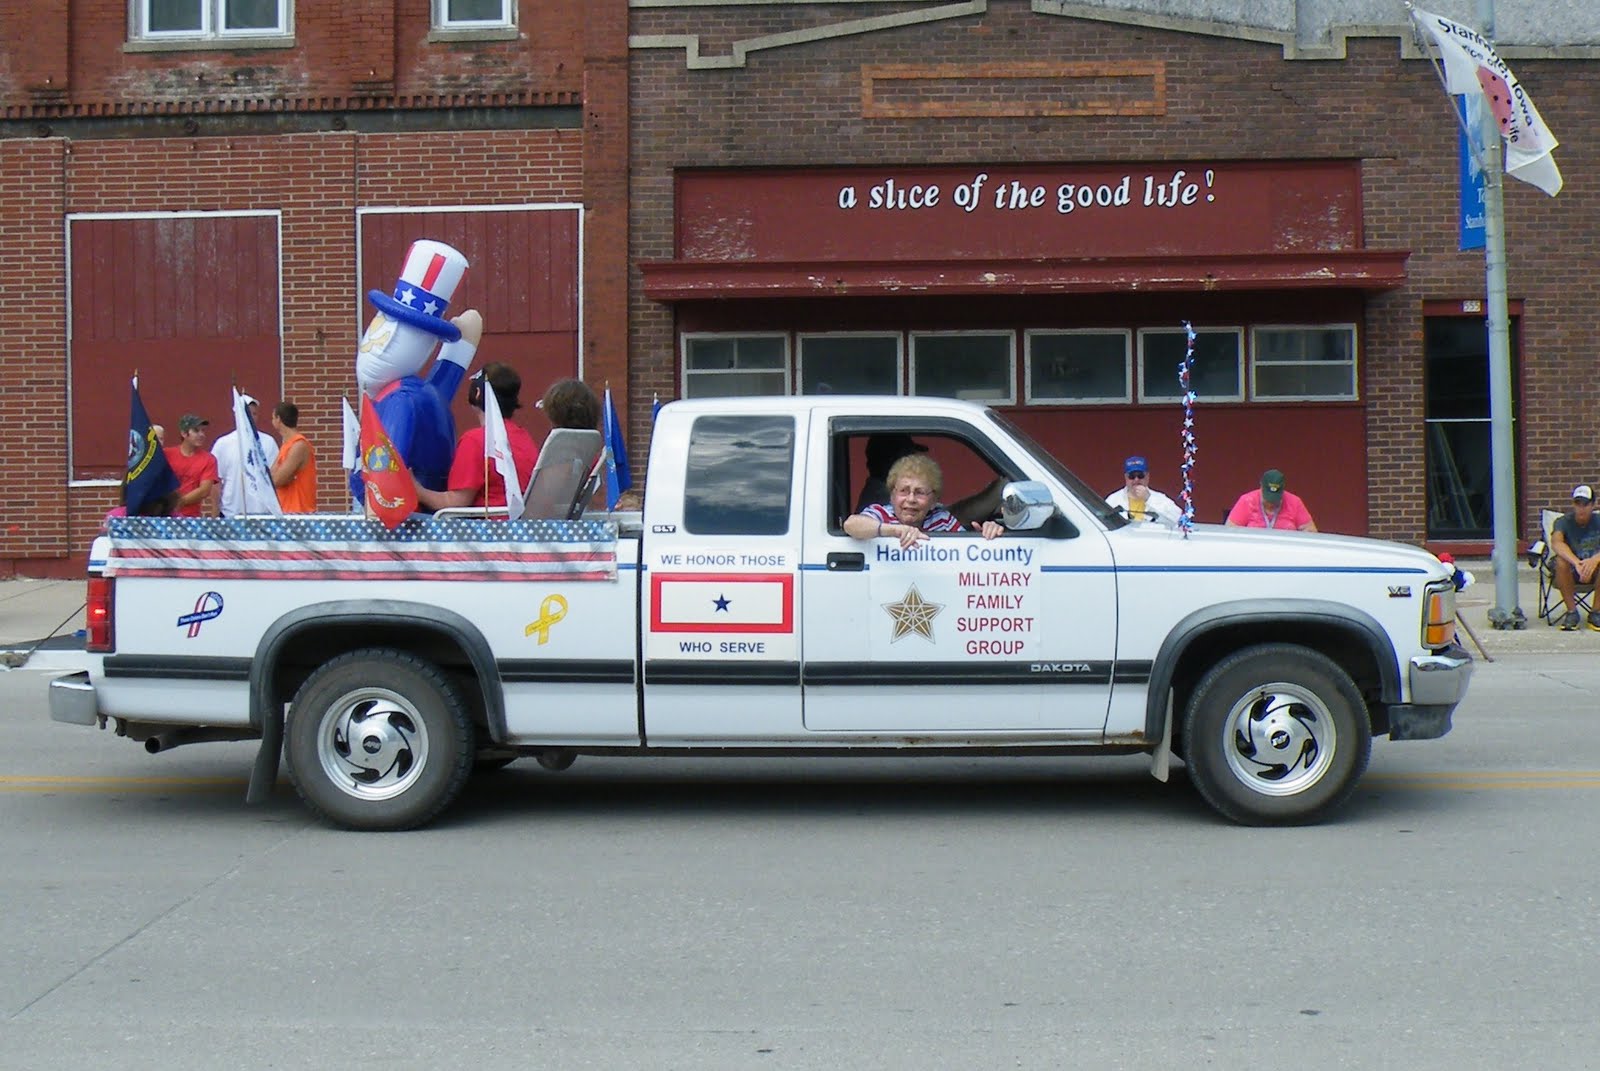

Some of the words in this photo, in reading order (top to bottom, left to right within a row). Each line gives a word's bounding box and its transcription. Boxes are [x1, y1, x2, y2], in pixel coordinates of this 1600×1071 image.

[1511, 81, 1533, 127] Iowa
[838, 184, 856, 209] a
[868, 178, 940, 210] slice
[952, 173, 988, 213] of
[994, 180, 1047, 210] the
[1056, 176, 1132, 214] good
[652, 525, 676, 533] SLT
[660, 554, 682, 565] WE
[686, 554, 736, 566] HONOR
[740, 554, 786, 566] THOSE
[876, 544, 960, 562] Hamilton
[966, 544, 1034, 565] County
[958, 571, 1032, 587] MILITARY
[967, 594, 1024, 609] FAMILY
[957, 617, 1034, 632] SUPPORT
[679, 641, 712, 653] WHO
[719, 641, 766, 653] SERVE
[966, 640, 1025, 655] GROUP
[1030, 663, 1092, 673] DAKOTA
